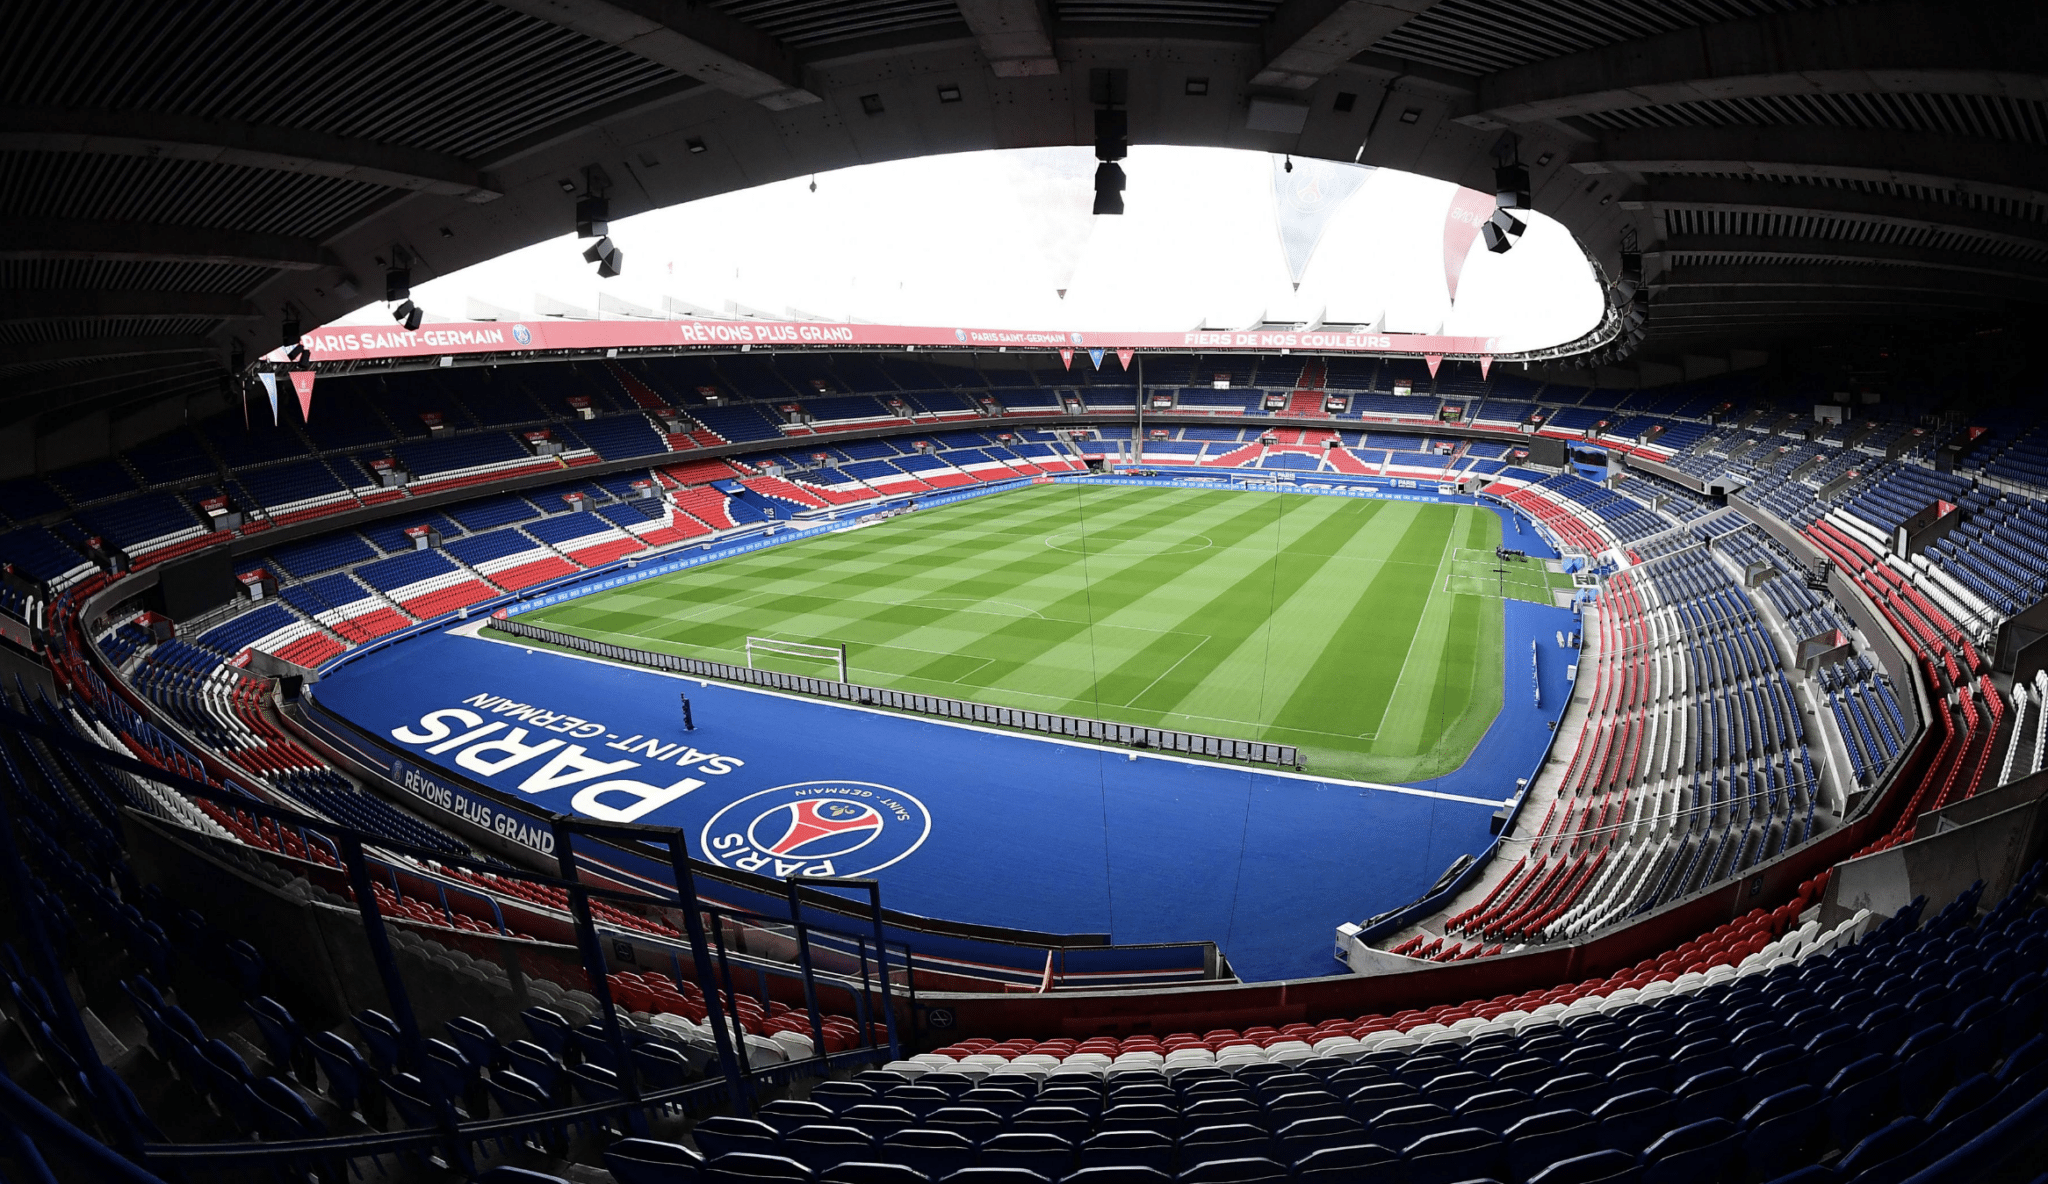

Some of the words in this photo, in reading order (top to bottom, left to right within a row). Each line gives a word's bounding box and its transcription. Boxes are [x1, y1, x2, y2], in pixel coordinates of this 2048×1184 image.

[302, 334, 360, 352] PARIS
[360, 329, 504, 350] SAINT-GERMAIN
[681, 322, 753, 341] RÊVONS
[755, 325, 798, 341] PLUS
[799, 326, 853, 341] GRAND
[971, 331, 998, 342] PARIS
[999, 332, 1065, 343] SAINT-GERMAIN
[1184, 333, 1232, 345] FIERS
[1236, 333, 1257, 345] DE
[1261, 334, 1297, 346] NOS
[1301, 334, 1391, 348] COULEURS
[391, 708, 706, 823] PARIS
[404, 769, 452, 809] RÊVONS
[454, 795, 492, 828] PLUS
[494, 814, 555, 854] GRAND
[713, 832, 836, 877] PARIS
